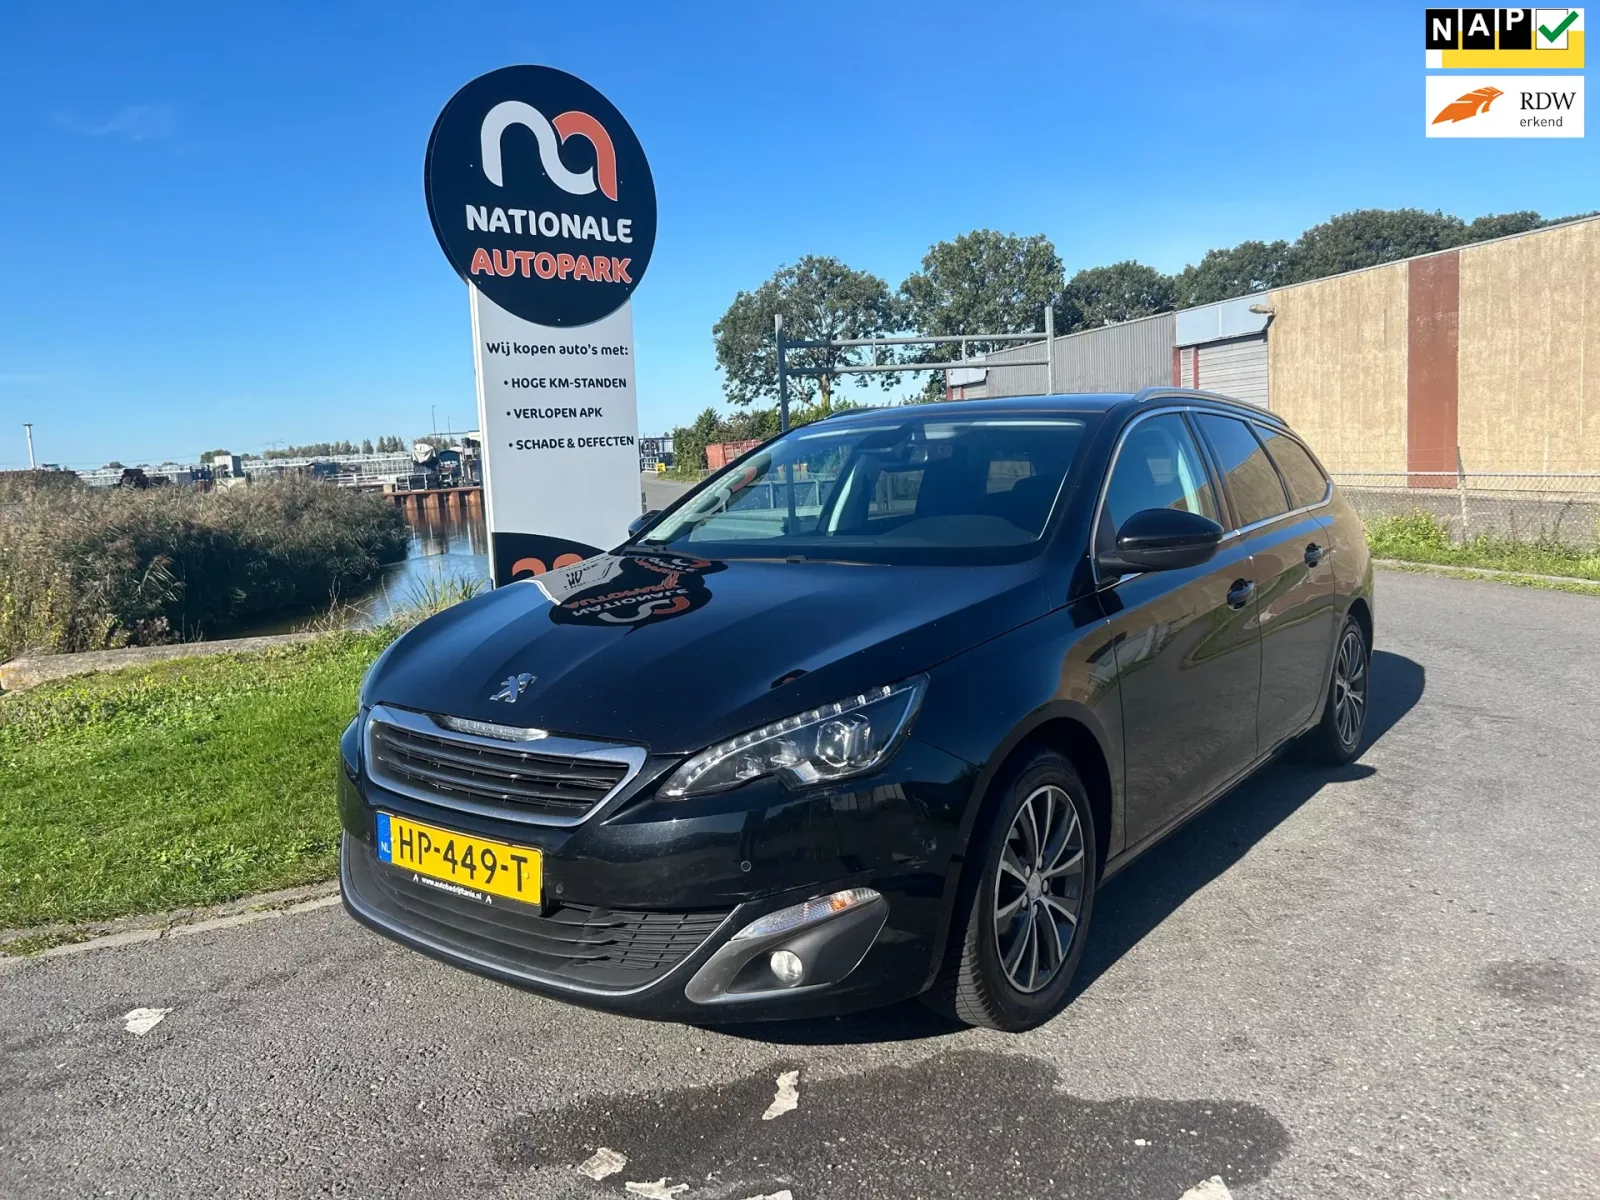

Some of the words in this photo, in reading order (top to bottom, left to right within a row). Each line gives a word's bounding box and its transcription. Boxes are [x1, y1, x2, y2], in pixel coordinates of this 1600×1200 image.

[465, 204, 633, 243] NATIONALE
[471, 247, 632, 284] AUTOPARK
[486, 342, 511, 356] Wij
[513, 342, 556, 357] kopen
[559, 343, 598, 355] auto's
[601, 344, 629, 355] met:
[511, 377, 546, 388] HOGE
[549, 377, 627, 388] KM-STANDEN
[514, 407, 577, 419] VERLOPEN
[579, 407, 603, 418] APK
[516, 438, 565, 450] SCHADE
[567, 438, 576, 448] &
[577, 436, 635, 447] DEFECTEN
[380, 841, 391, 853] NL
[399, 825, 528, 892] HP-449-T
